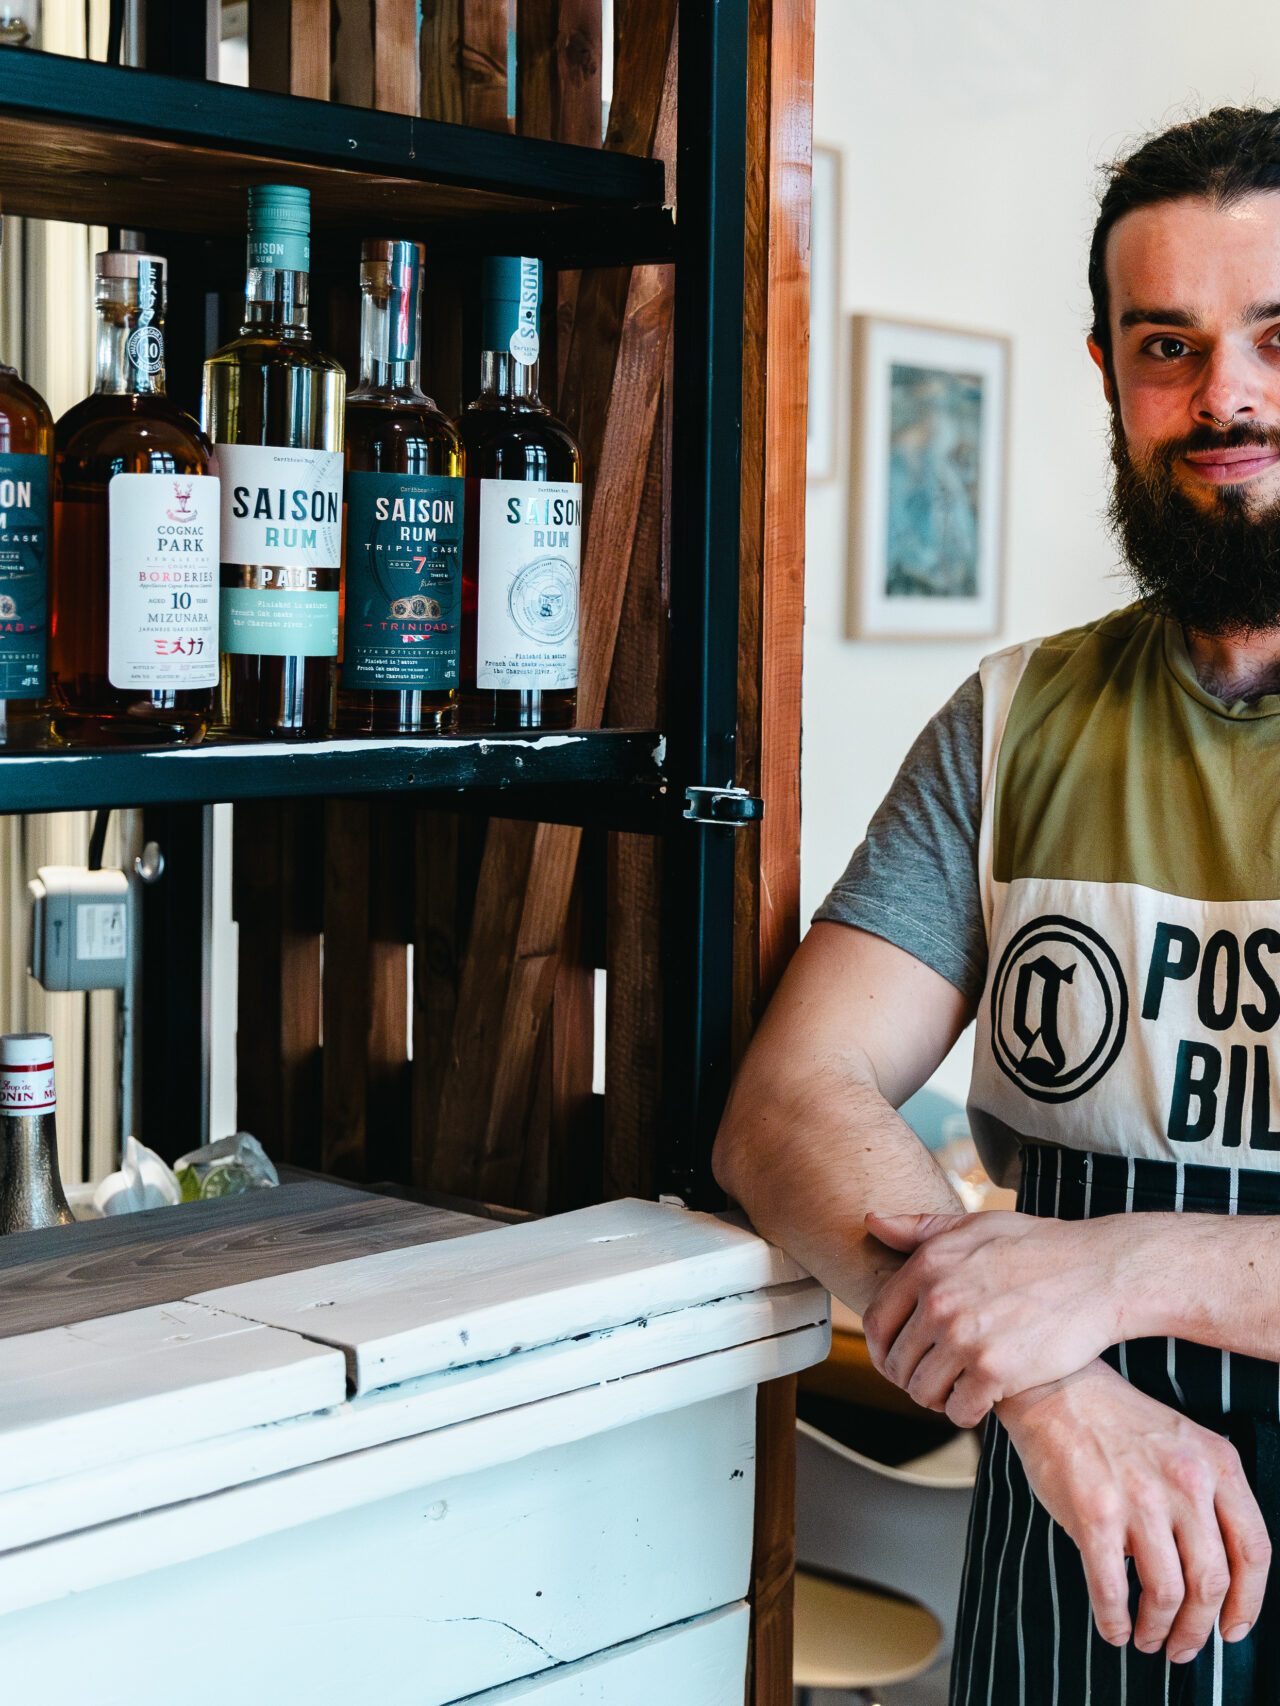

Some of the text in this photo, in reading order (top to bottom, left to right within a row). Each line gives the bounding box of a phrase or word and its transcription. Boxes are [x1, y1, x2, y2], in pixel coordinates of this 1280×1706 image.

[520, 263, 539, 339] SAISON
[143, 342, 158, 358] 10
[232, 486, 338, 523] SAISON
[375, 497, 454, 523] SAISON
[506, 497, 580, 526] SAISON
[157, 525, 204, 536] COGNAC
[265, 527, 317, 549] RUM
[400, 527, 437, 542] RUM
[533, 530, 569, 548] RUM
[157, 538, 204, 552] PARK
[364, 544, 422, 552] TRIPLE
[412, 555, 427, 575] 7
[138, 571, 214, 582] BORDERIES
[259, 568, 318, 588] PALE
[171, 592, 192, 610] 10
[147, 613, 209, 623] MIZUNARA
[380, 622, 448, 631] TRINIDAD
[154, 636, 204, 656] ミズナラ
